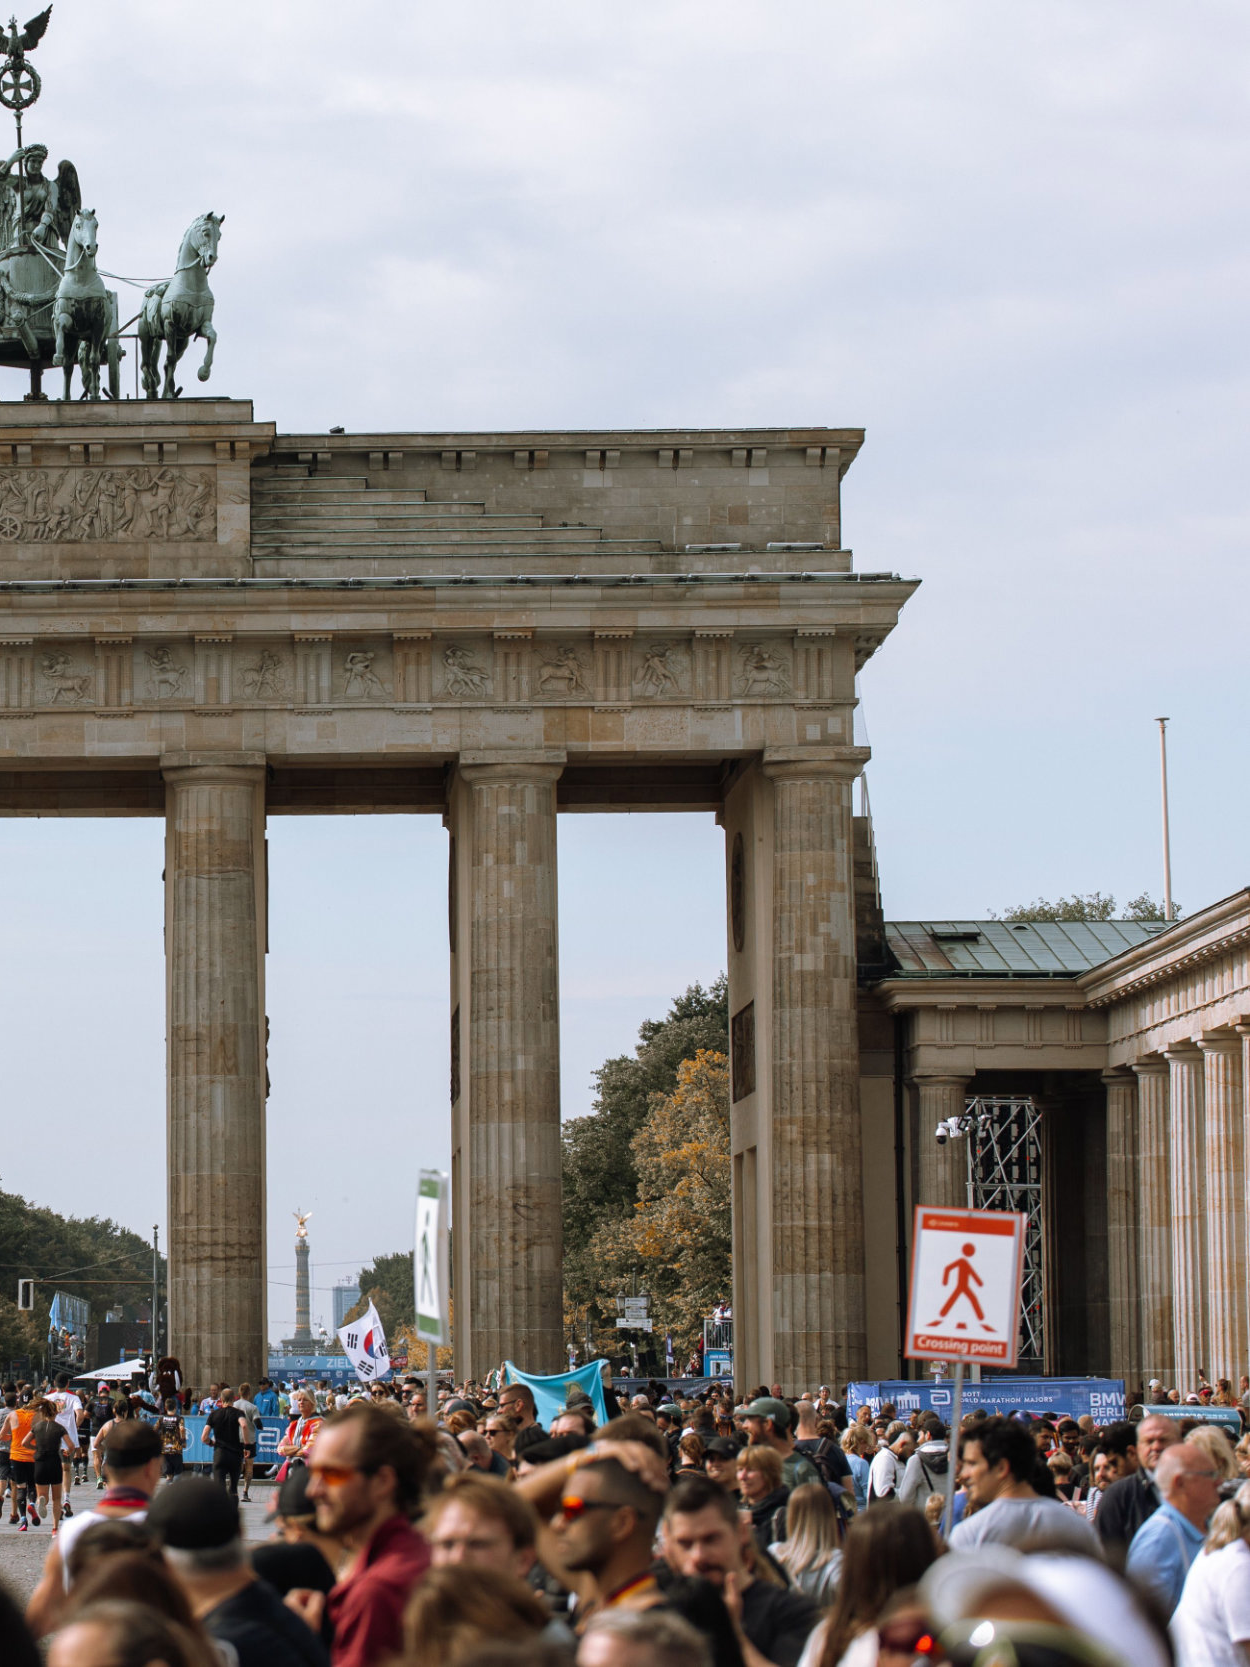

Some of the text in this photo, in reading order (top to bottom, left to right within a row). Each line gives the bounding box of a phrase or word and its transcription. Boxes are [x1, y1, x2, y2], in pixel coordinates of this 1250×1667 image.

[917, 1336, 1004, 1356] Crossing point
[326, 1358, 352, 1369] ZIEL
[1090, 1407, 1125, 1417] BERLI
